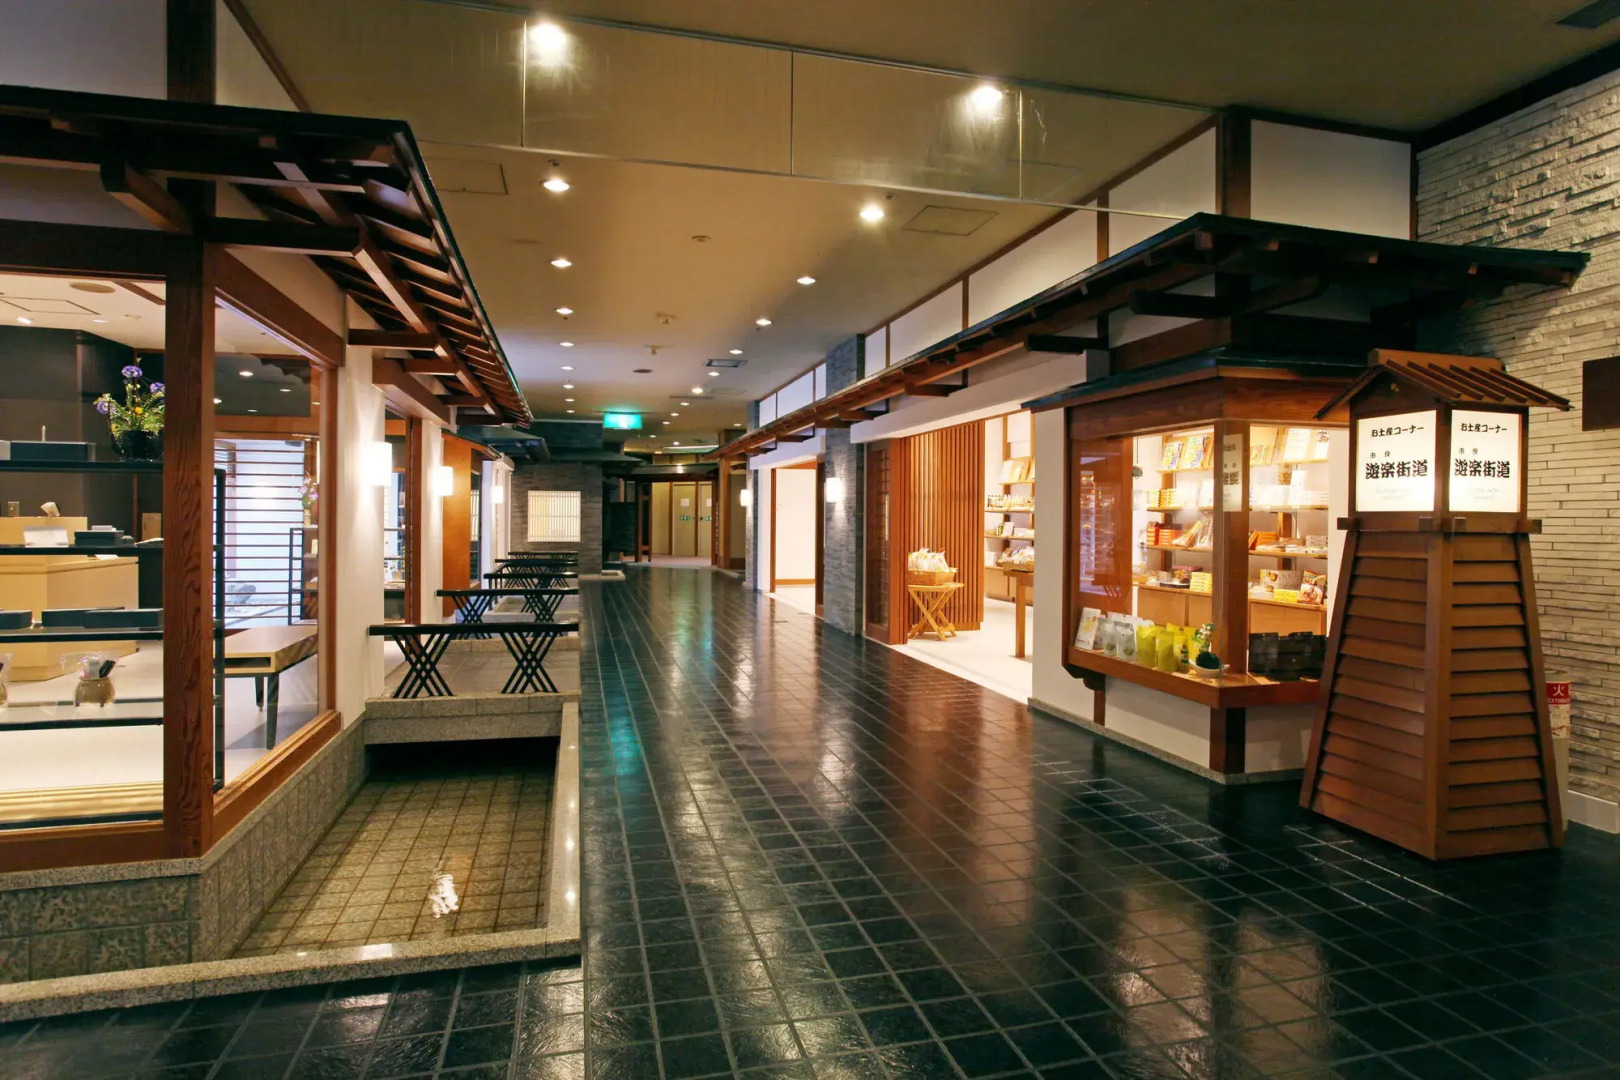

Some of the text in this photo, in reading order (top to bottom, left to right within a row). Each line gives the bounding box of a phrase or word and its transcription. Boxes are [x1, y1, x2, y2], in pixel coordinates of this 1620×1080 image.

[1371, 425, 1425, 438] お土産コーナー
[1460, 422, 1508, 434] お土産コーナー
